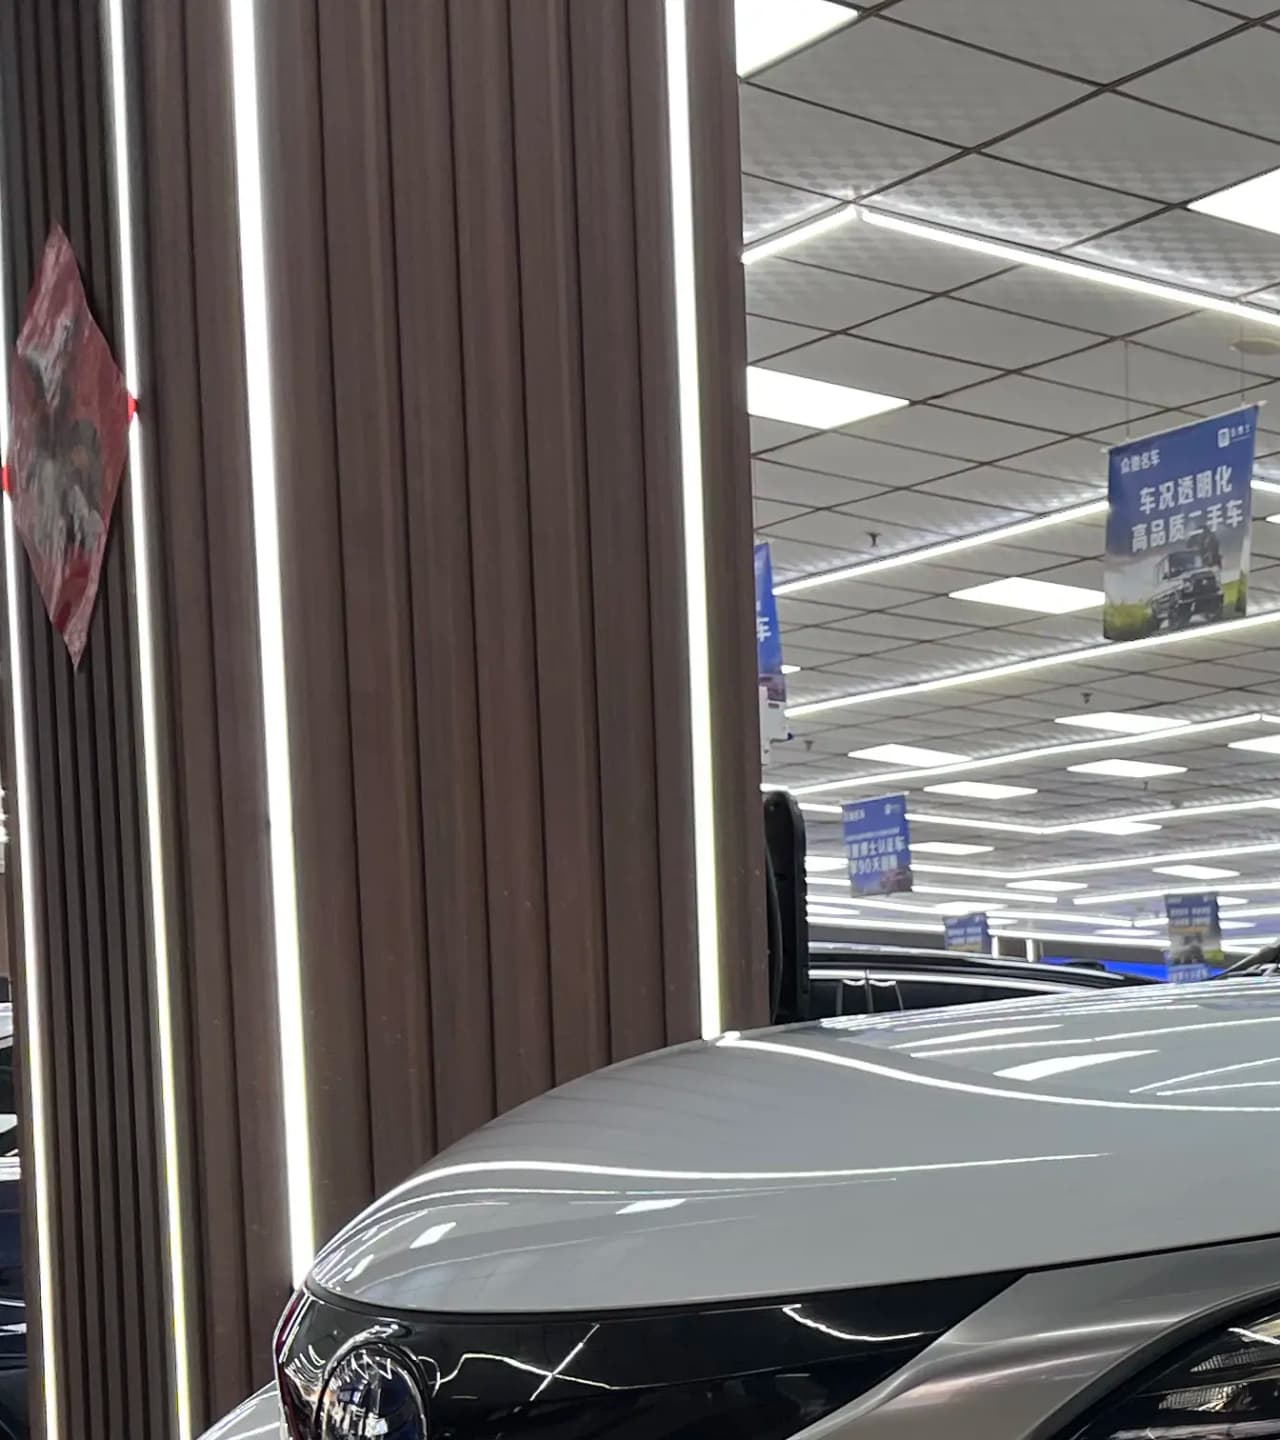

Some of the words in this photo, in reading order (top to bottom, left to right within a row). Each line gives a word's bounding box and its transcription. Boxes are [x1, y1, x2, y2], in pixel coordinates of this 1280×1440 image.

[1139, 465, 1233, 515] 车况透明化
[1131, 499, 1244, 553] 高品质二手车
